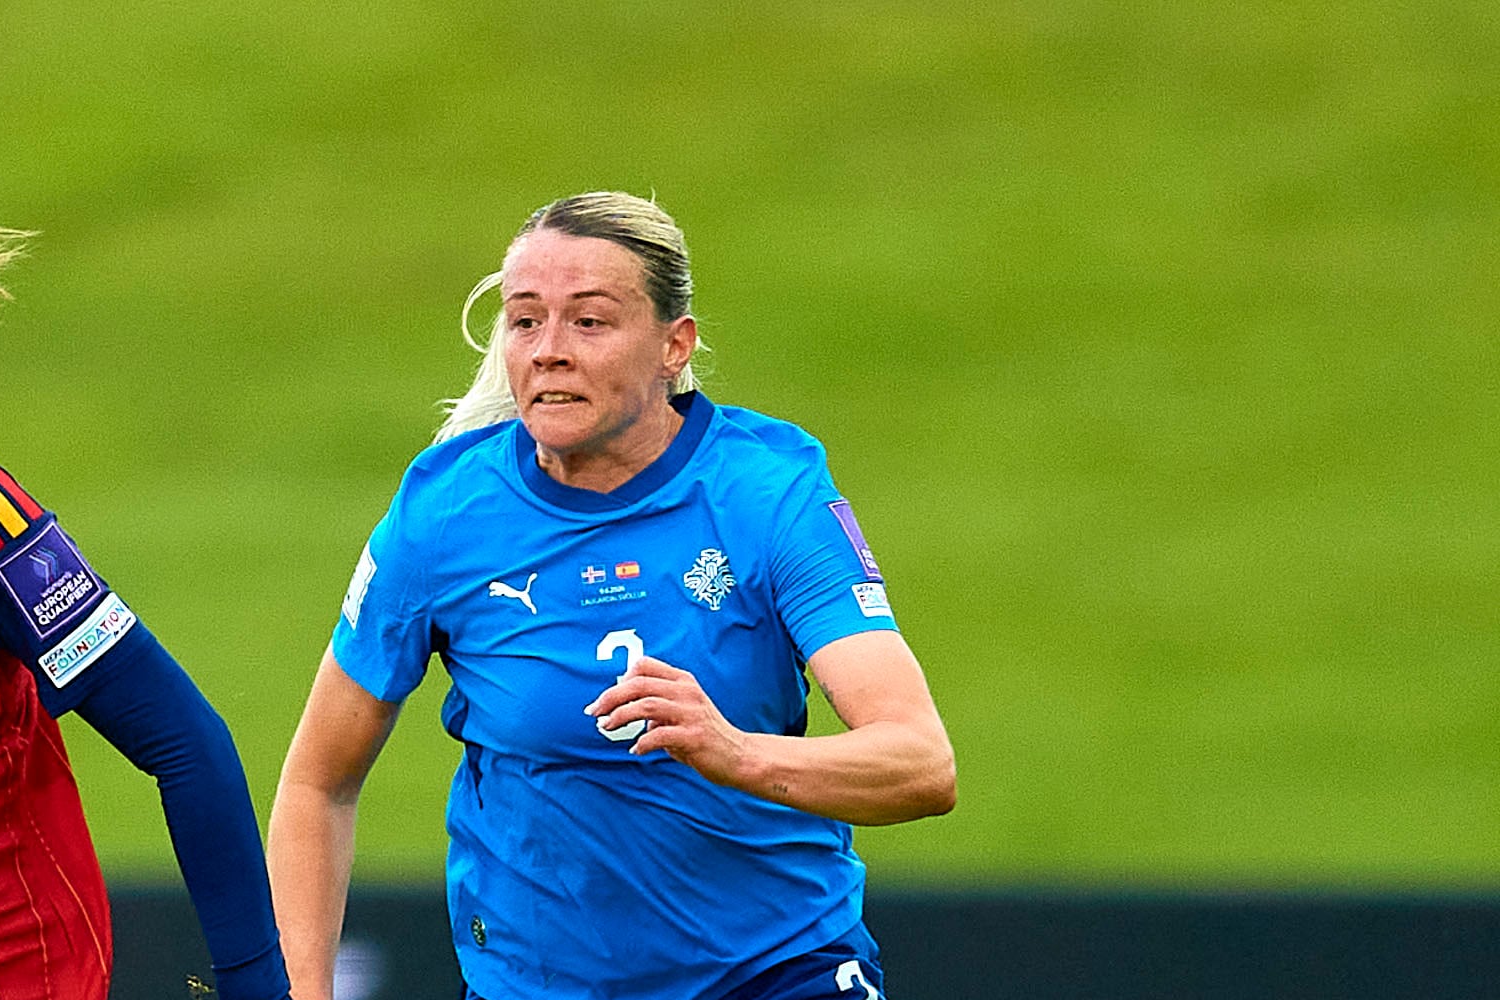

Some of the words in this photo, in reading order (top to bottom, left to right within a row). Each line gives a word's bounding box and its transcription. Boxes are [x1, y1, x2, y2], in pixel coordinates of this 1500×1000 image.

[33, 570, 87, 617] EUROPEAN
[38, 578, 93, 626] QUALIFIERS
[48, 603, 125, 676] FOUNDATION
